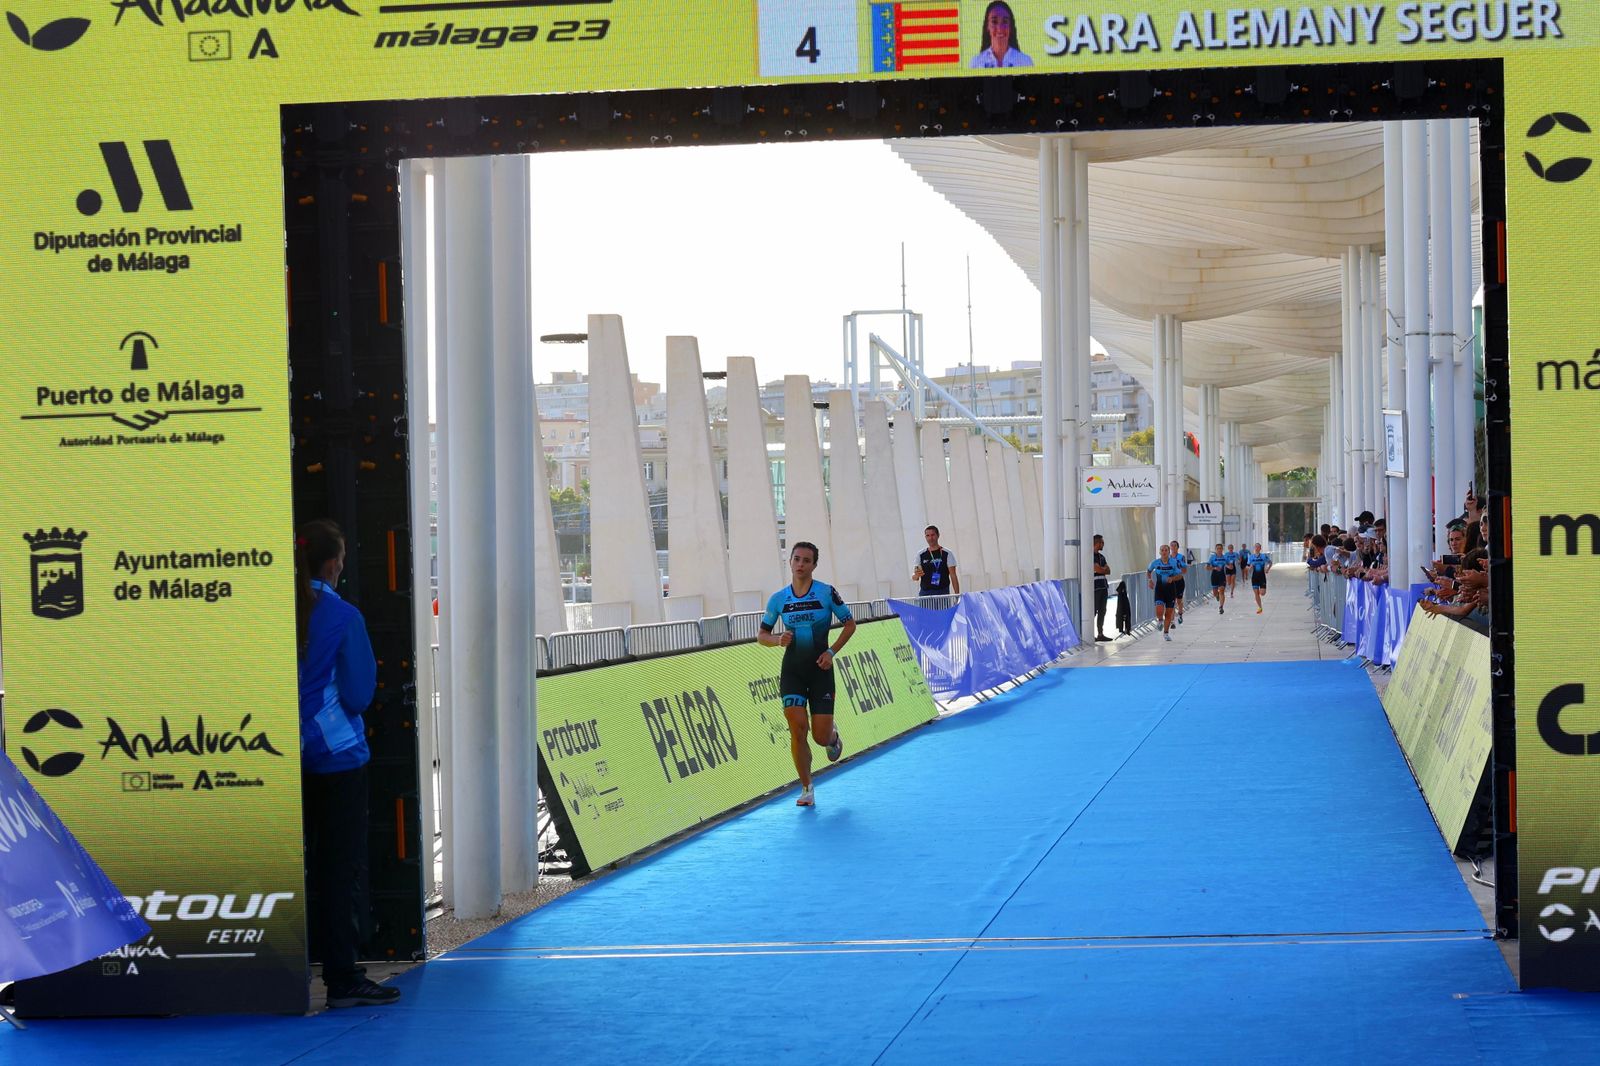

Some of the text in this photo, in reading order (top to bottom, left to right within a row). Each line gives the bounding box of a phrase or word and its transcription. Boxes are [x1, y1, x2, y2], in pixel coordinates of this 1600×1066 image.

[374, 19, 611, 49] málaga 23
[1043, 0, 1564, 57] SARA ALEMANY SEGUER
[795, 26, 821, 65] 4
[33, 223, 243, 253] Diputación Provincial
[87, 252, 190, 275] de Málaga
[36, 380, 244, 407] Puerto de Málaga
[59, 431, 225, 447] Autoridad Portuaria de Málaga
[1107, 477, 1155, 490] Andalucía
[113, 547, 274, 603] Ayuntamiento de Málaga
[835, 648, 895, 715] PELIGRO
[97, 713, 285, 763] Andalucía
[640, 685, 739, 784] PELIGRO
[206, 928, 265, 944] FETRI
